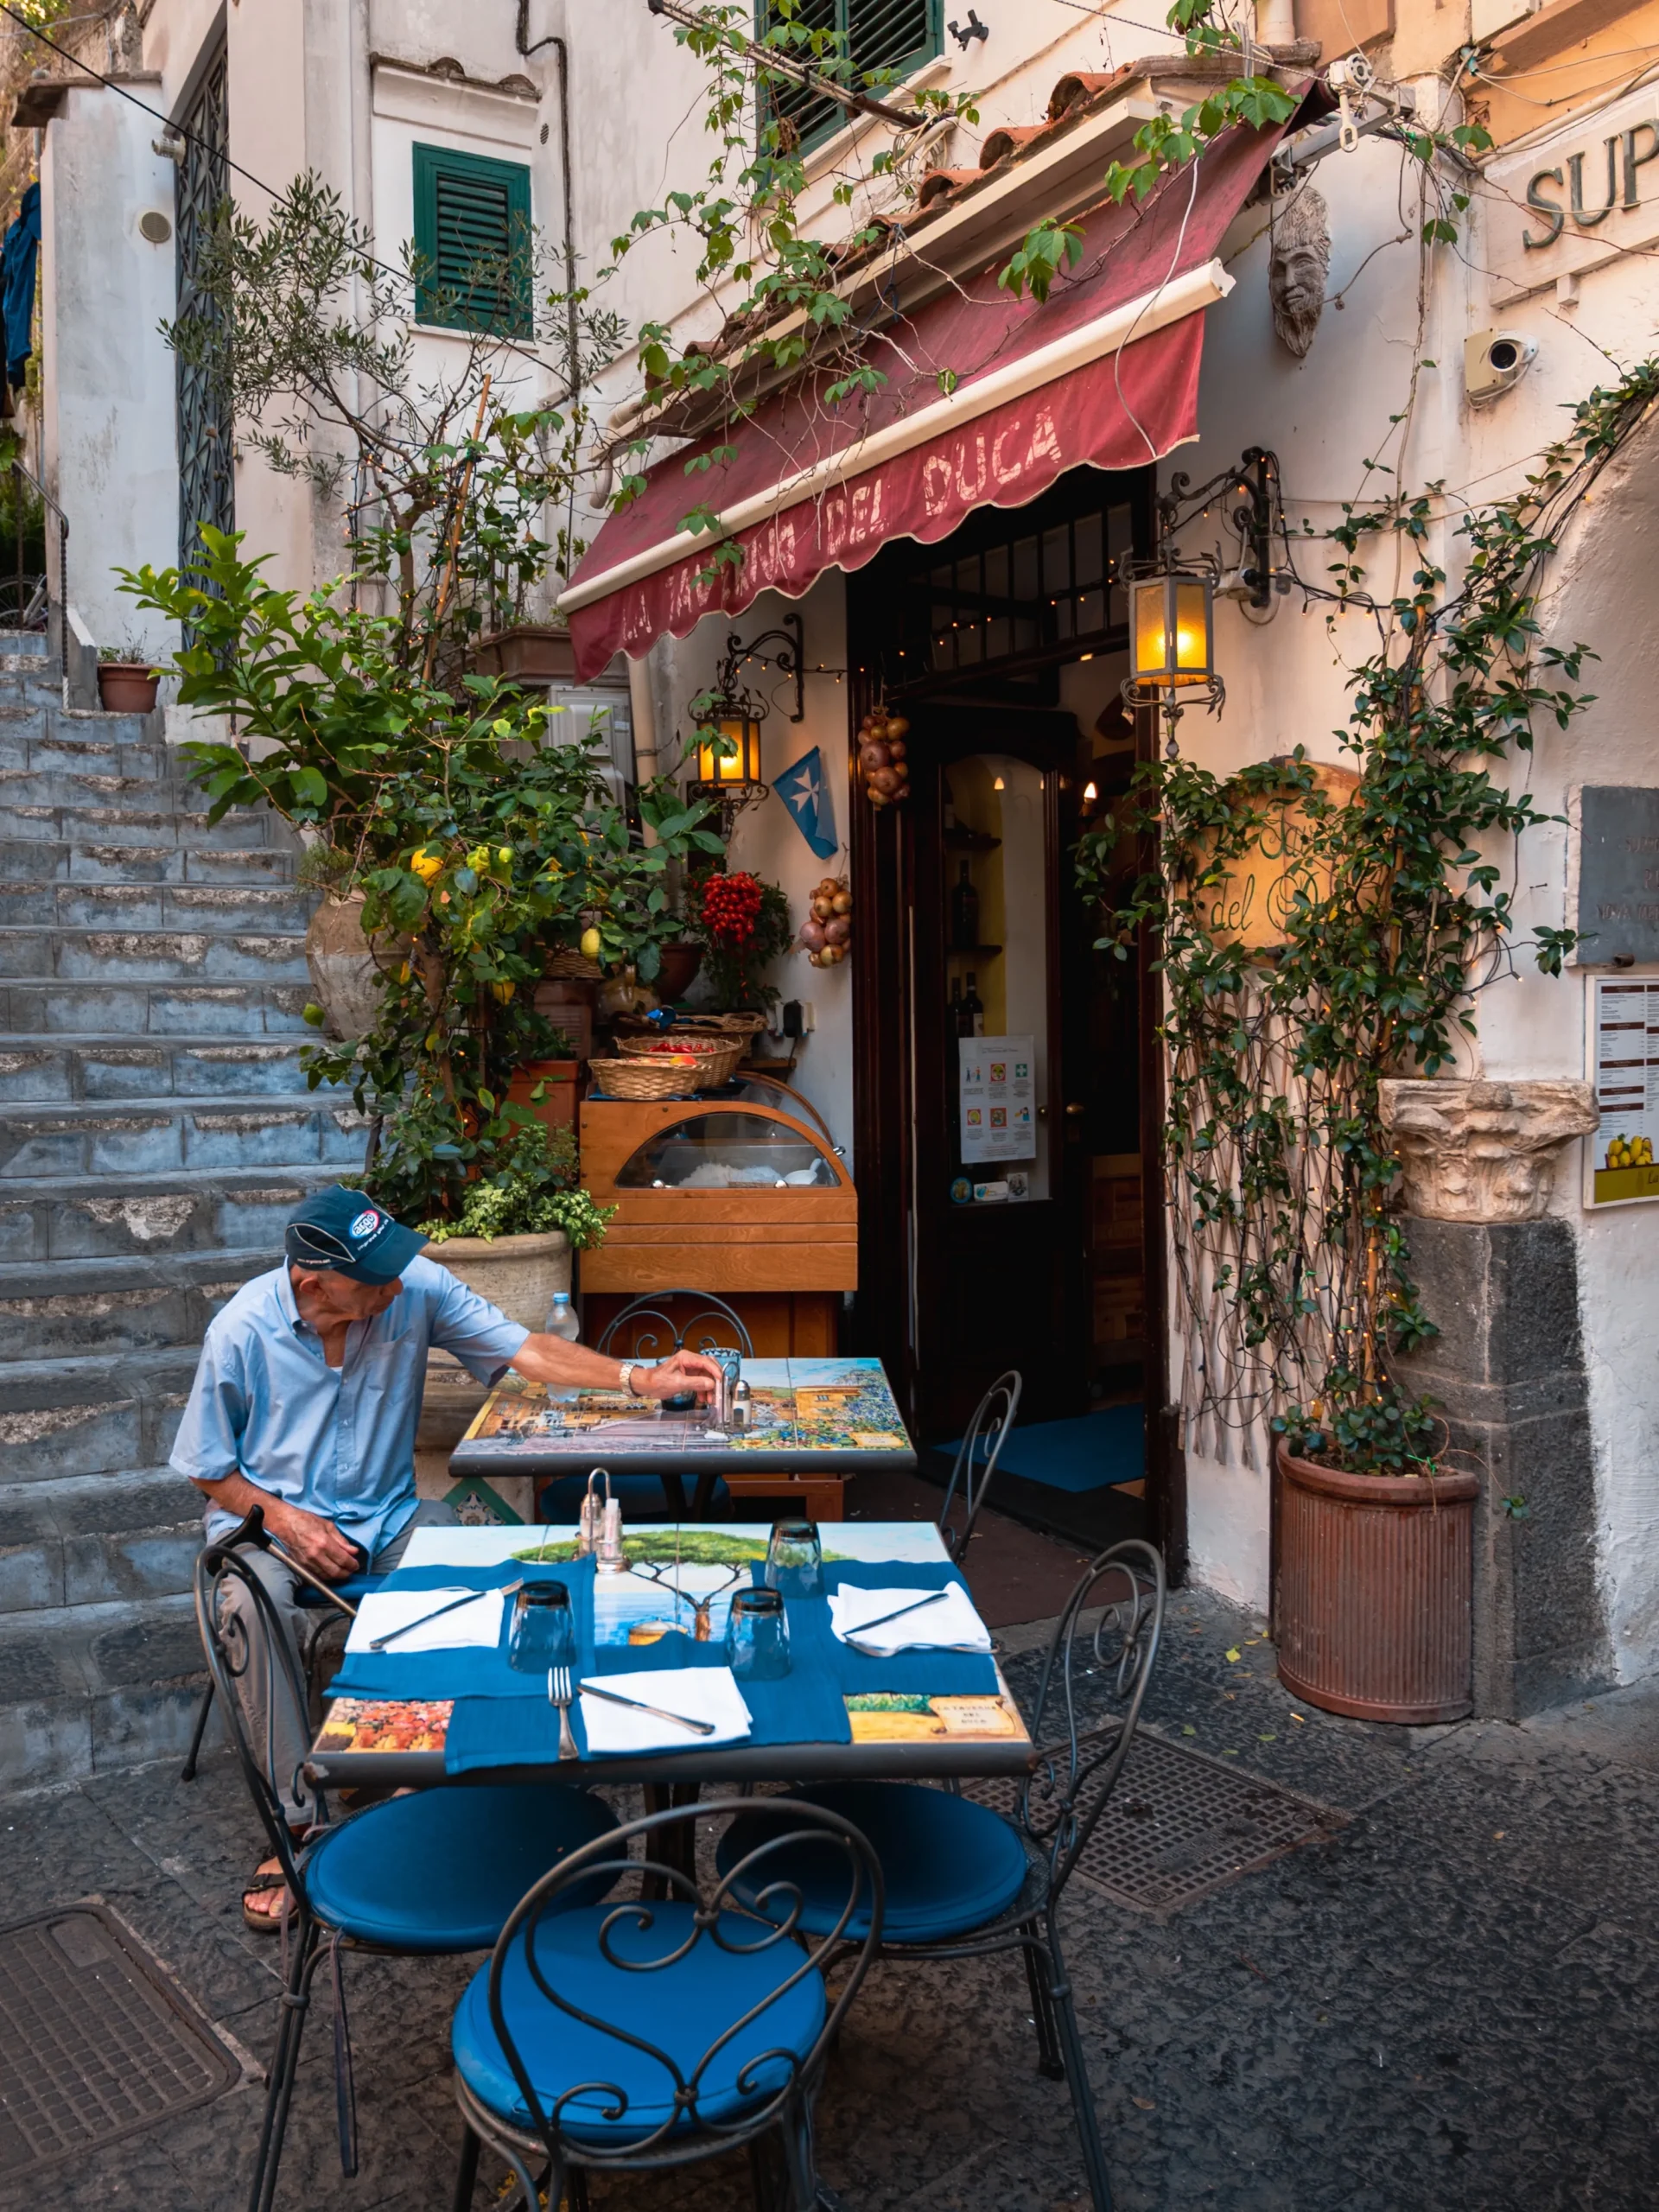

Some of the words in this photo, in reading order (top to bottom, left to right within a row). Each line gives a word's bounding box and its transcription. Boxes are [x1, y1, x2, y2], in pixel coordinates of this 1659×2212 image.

[826, 479, 890, 556] DEL
[923, 406, 1063, 517] DUCA
[1211, 873, 1255, 932] del
[353, 1213, 375, 1236] argo
